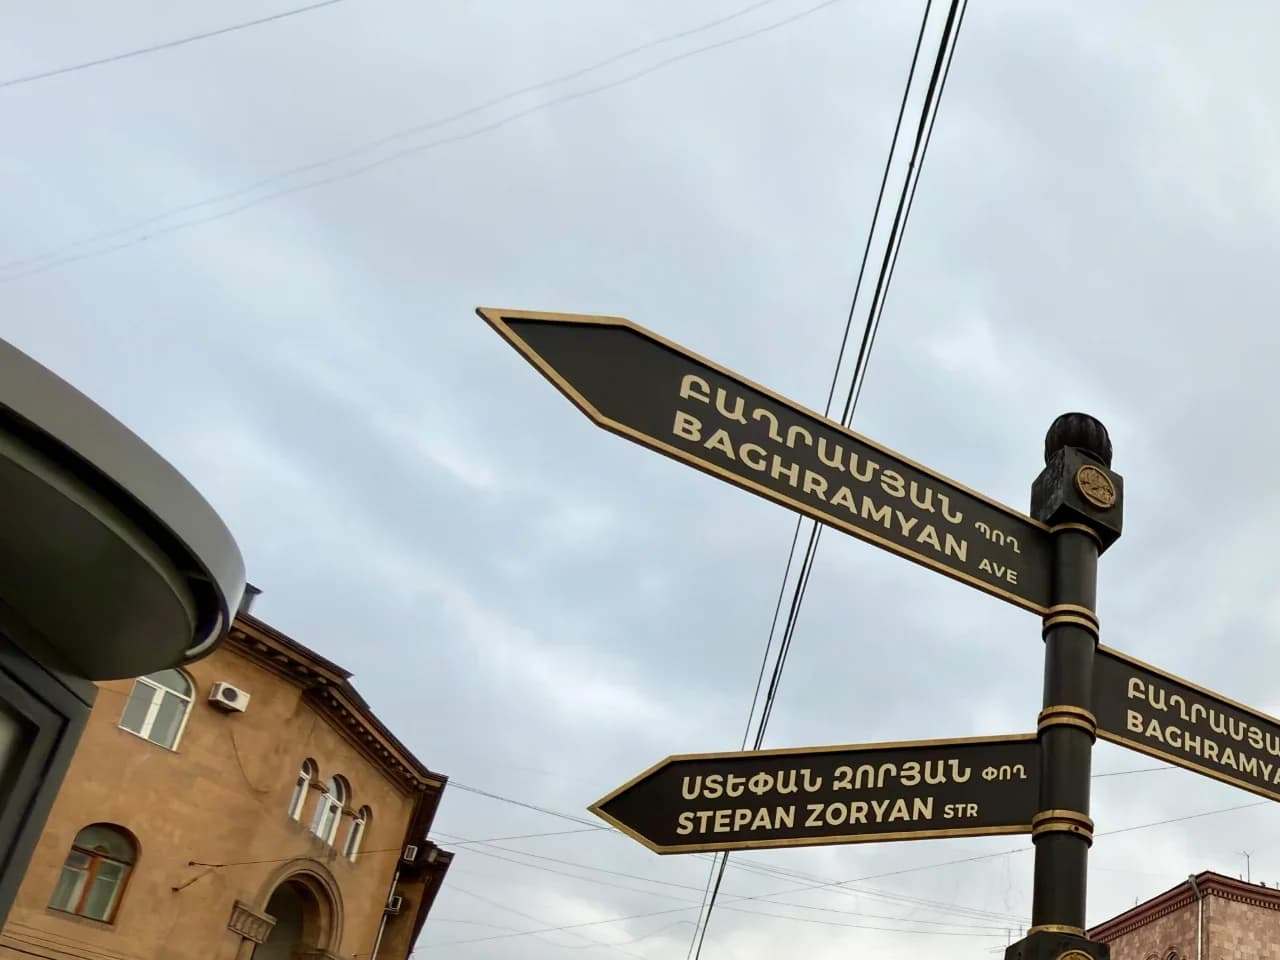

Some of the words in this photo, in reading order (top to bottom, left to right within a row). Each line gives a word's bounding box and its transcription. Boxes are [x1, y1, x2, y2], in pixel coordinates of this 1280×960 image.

[672, 410, 968, 562] BAGHRAMYAN
[978, 558, 1018, 585] AVE
[679, 374, 963, 525] ԲԱՂՐԱՄՅԱՆ
[675, 805, 796, 835] STEPAN
[804, 797, 934, 828] ZORYAN
[943, 803, 978, 820] STR
[681, 768, 823, 800] ՍՏԵՓԱՆ
[832, 759, 972, 791] ԶՈՐՅԱՆ
